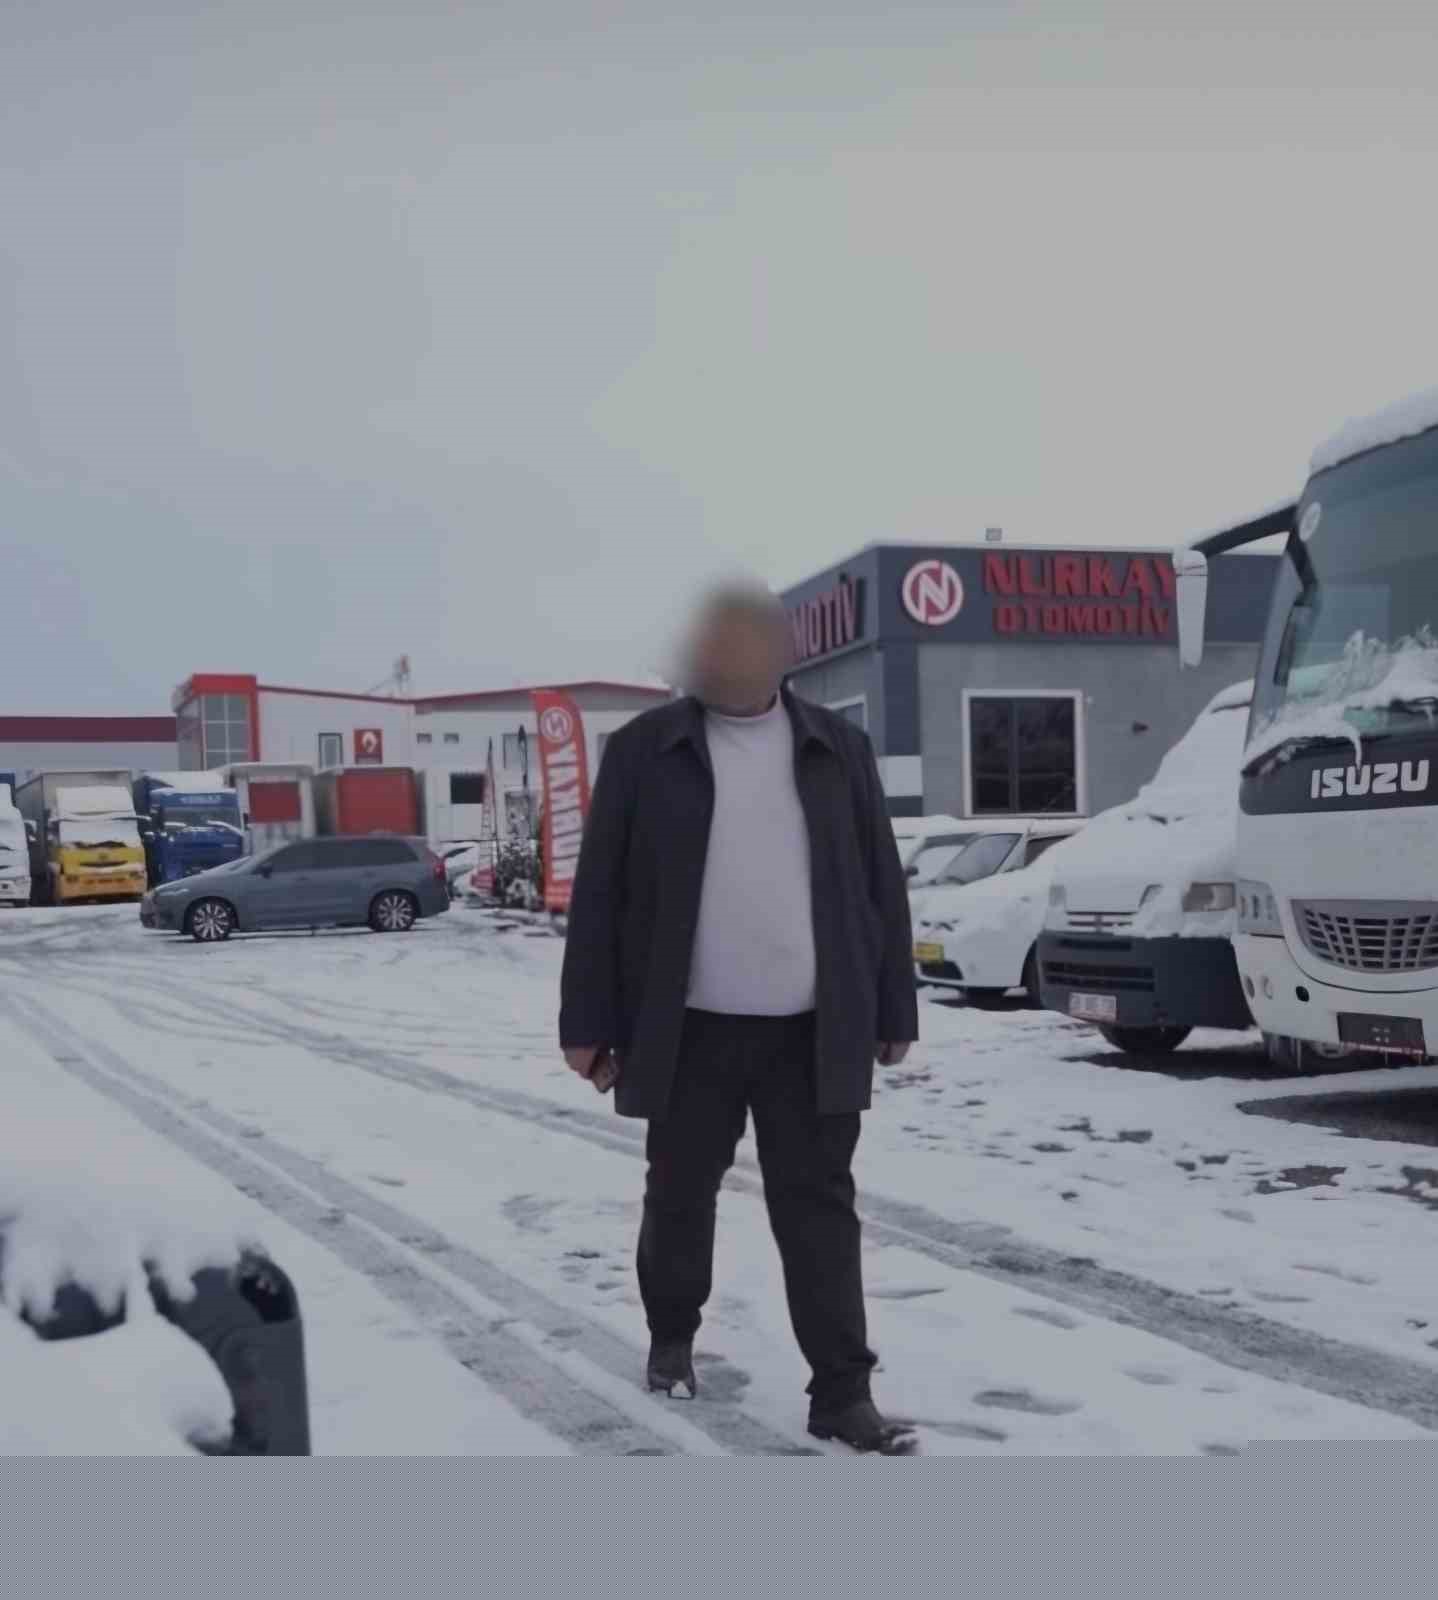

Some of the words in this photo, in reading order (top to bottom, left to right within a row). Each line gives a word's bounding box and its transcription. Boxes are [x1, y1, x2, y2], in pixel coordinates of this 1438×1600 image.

[984, 553, 1177, 597] NURKAY
[786, 574, 857, 659] MOTİV
[1310, 760, 1430, 799] ISUZU
